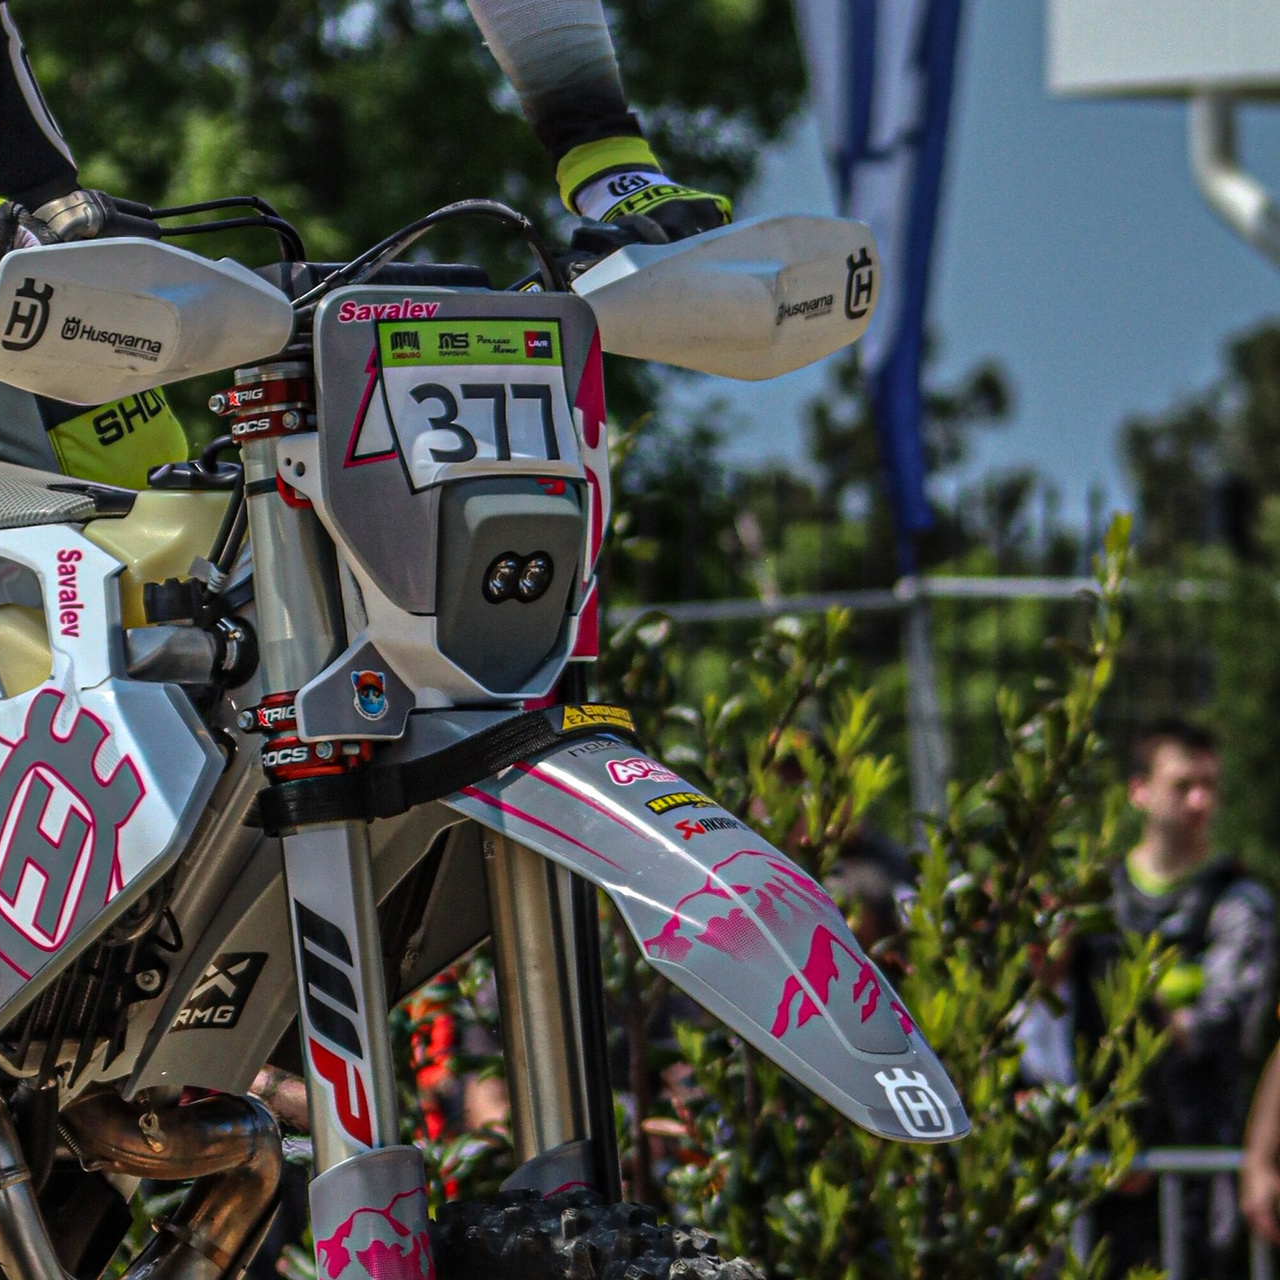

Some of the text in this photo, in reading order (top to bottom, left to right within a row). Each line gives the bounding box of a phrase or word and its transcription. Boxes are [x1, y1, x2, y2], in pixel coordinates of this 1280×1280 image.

[784, 294, 834, 318] Husqvarna
[79, 324, 163, 354] Husqvarna
[408, 382, 561, 464] 377
[56, 548, 83, 640] Savalev
[173, 1005, 235, 1027] RMG
